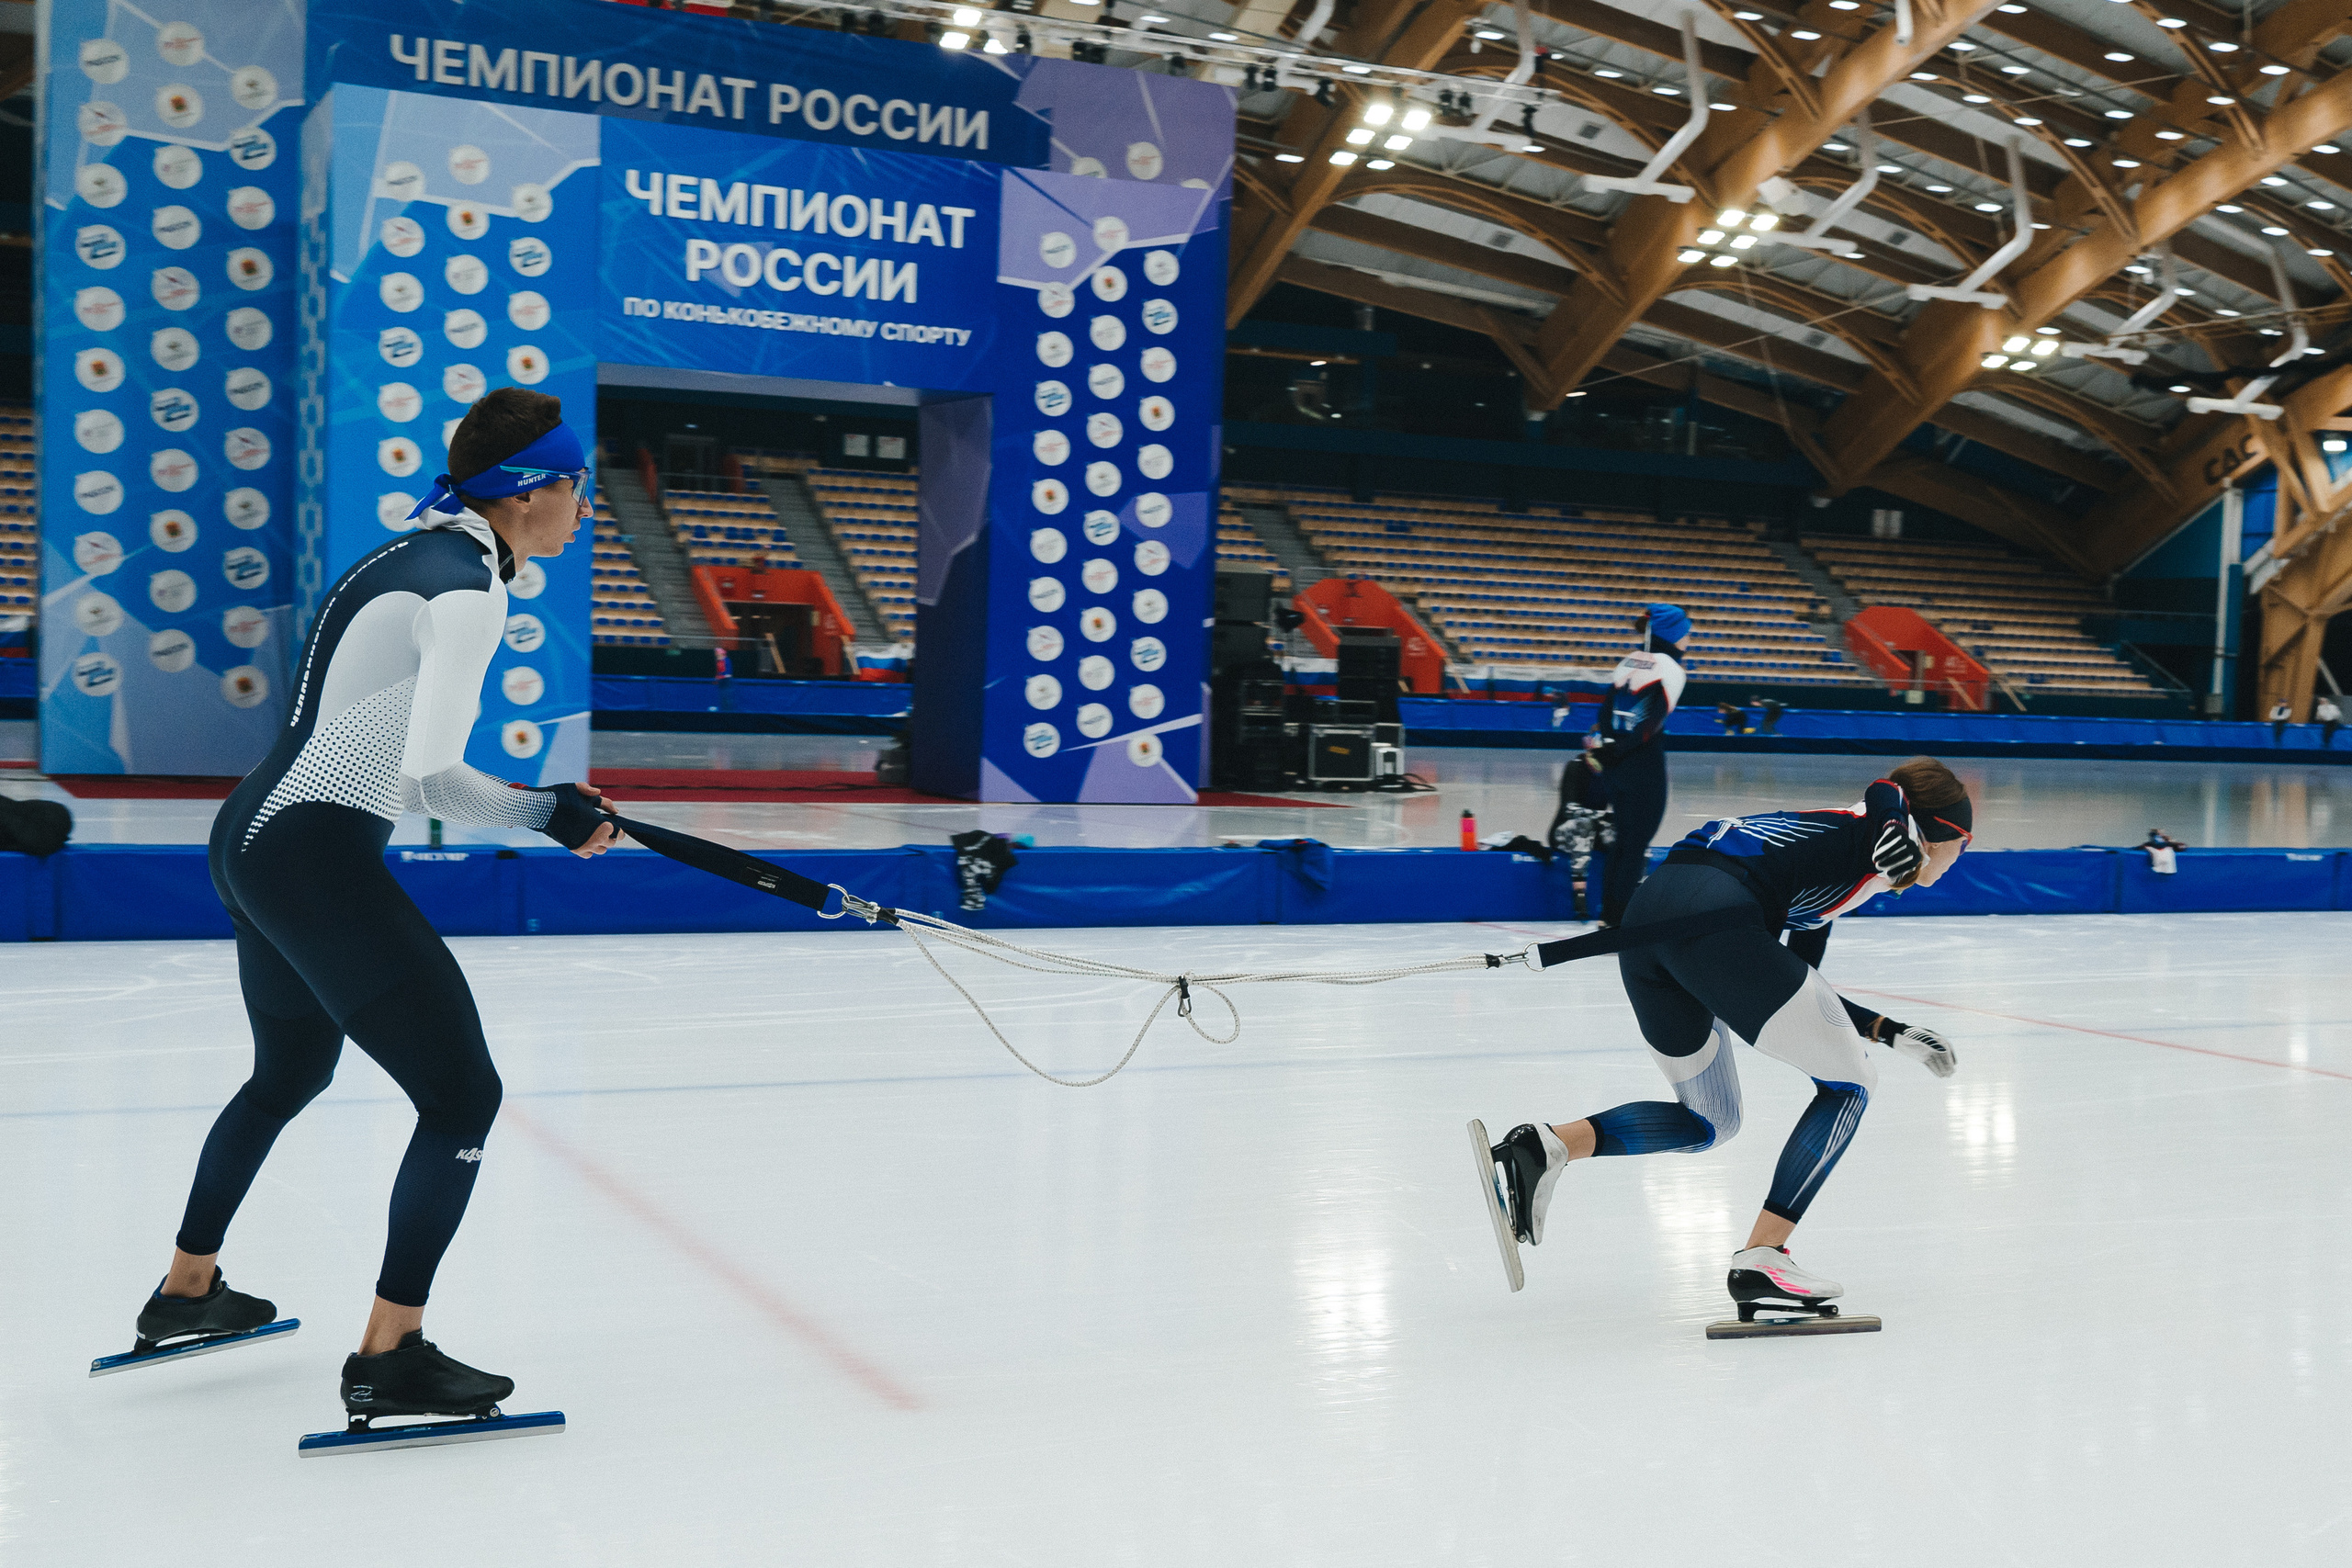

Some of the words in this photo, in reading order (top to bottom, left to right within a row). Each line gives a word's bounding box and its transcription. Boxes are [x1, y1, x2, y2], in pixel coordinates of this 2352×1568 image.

[390, 34, 757, 119] ЧЕМПИОНАТ
[769, 84, 989, 150] РОССИИ
[625, 169, 977, 249] ЧЕМПИОНАТ
[685, 238, 919, 304] РОССИИ
[623, 296, 662, 318] ПО
[662, 301, 879, 339] КОНЬКОБЕЖНОМУ
[880, 321, 972, 347] СПОРТУ
[517, 472, 547, 487] HUNTER
